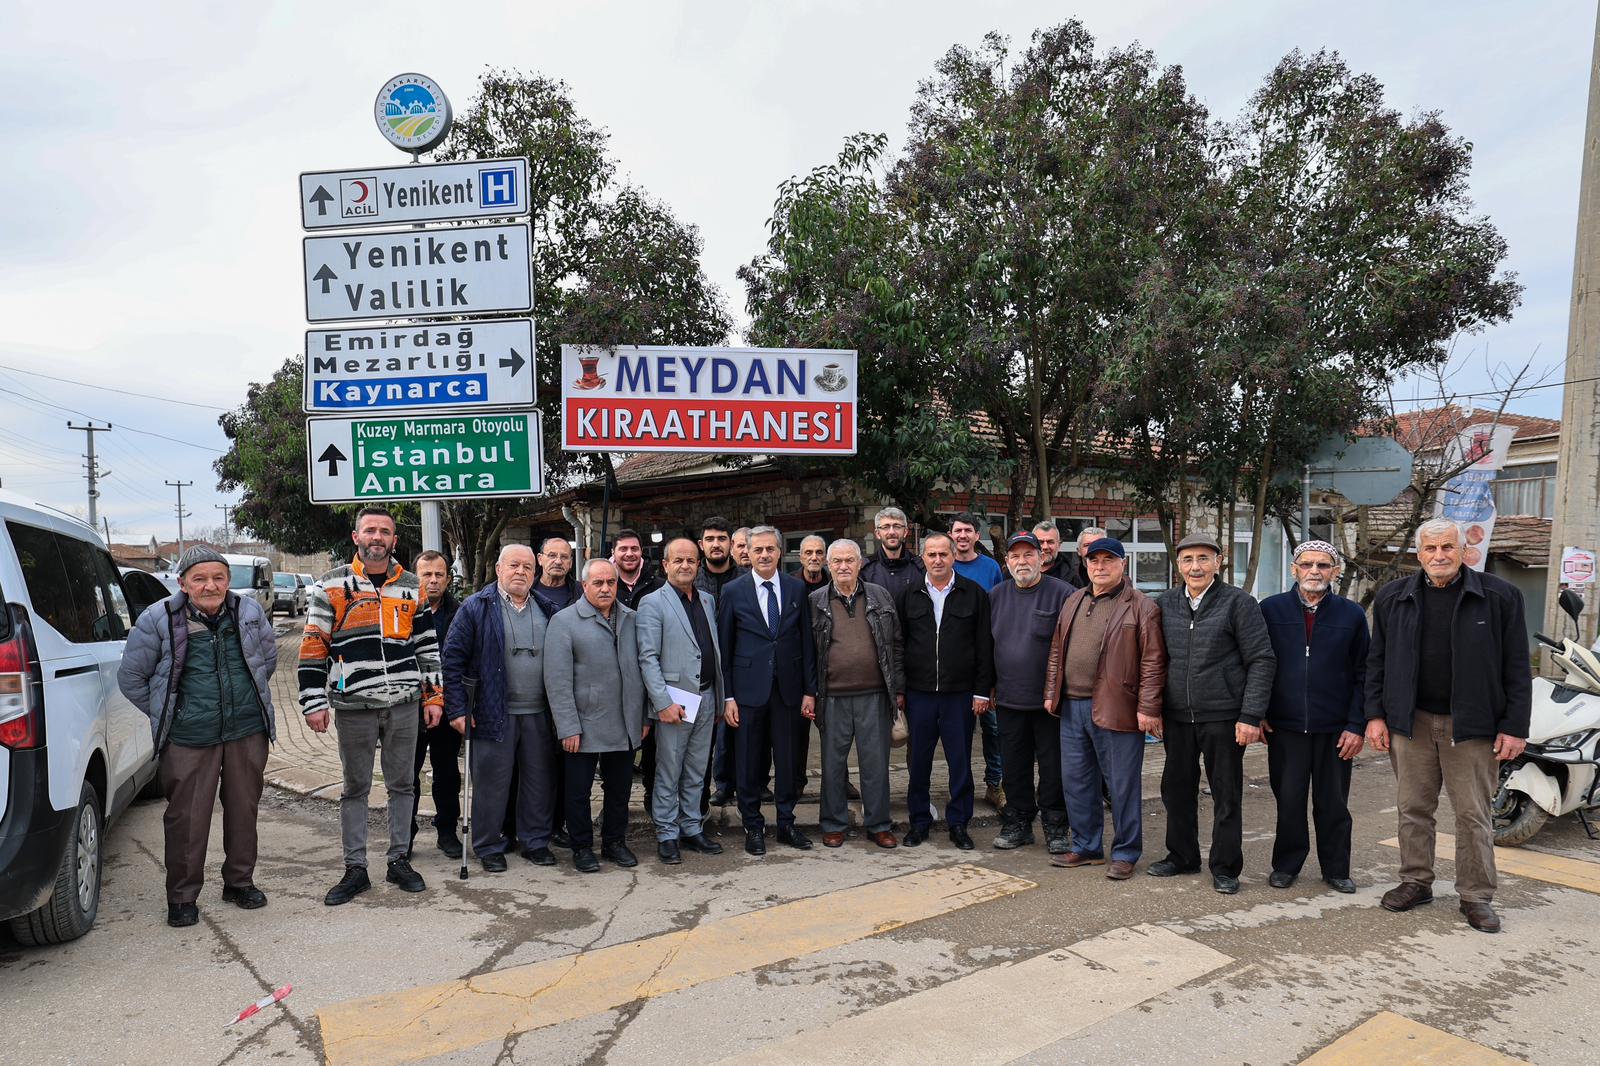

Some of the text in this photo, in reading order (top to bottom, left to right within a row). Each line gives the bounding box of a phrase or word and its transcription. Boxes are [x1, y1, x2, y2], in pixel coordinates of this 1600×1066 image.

[387, 78, 431, 92] SAKARYA
[383, 178, 473, 208] Yenikent
[487, 173, 510, 202] H
[345, 205, 375, 216] ACİL
[343, 234, 509, 270] Yenikent
[344, 278, 469, 311] Valilik
[325, 328, 473, 351] Emirdağ
[313, 351, 485, 374] Mezarlığı
[615, 355, 806, 395] MEYDAN
[320, 379, 481, 405] Kaynarca
[357, 417, 524, 441] Kuzey Marmara Otoyolu
[577, 403, 842, 441] KIRAATHANESİ
[358, 440, 514, 468] İstanbul
[360, 471, 495, 494] Ankara
